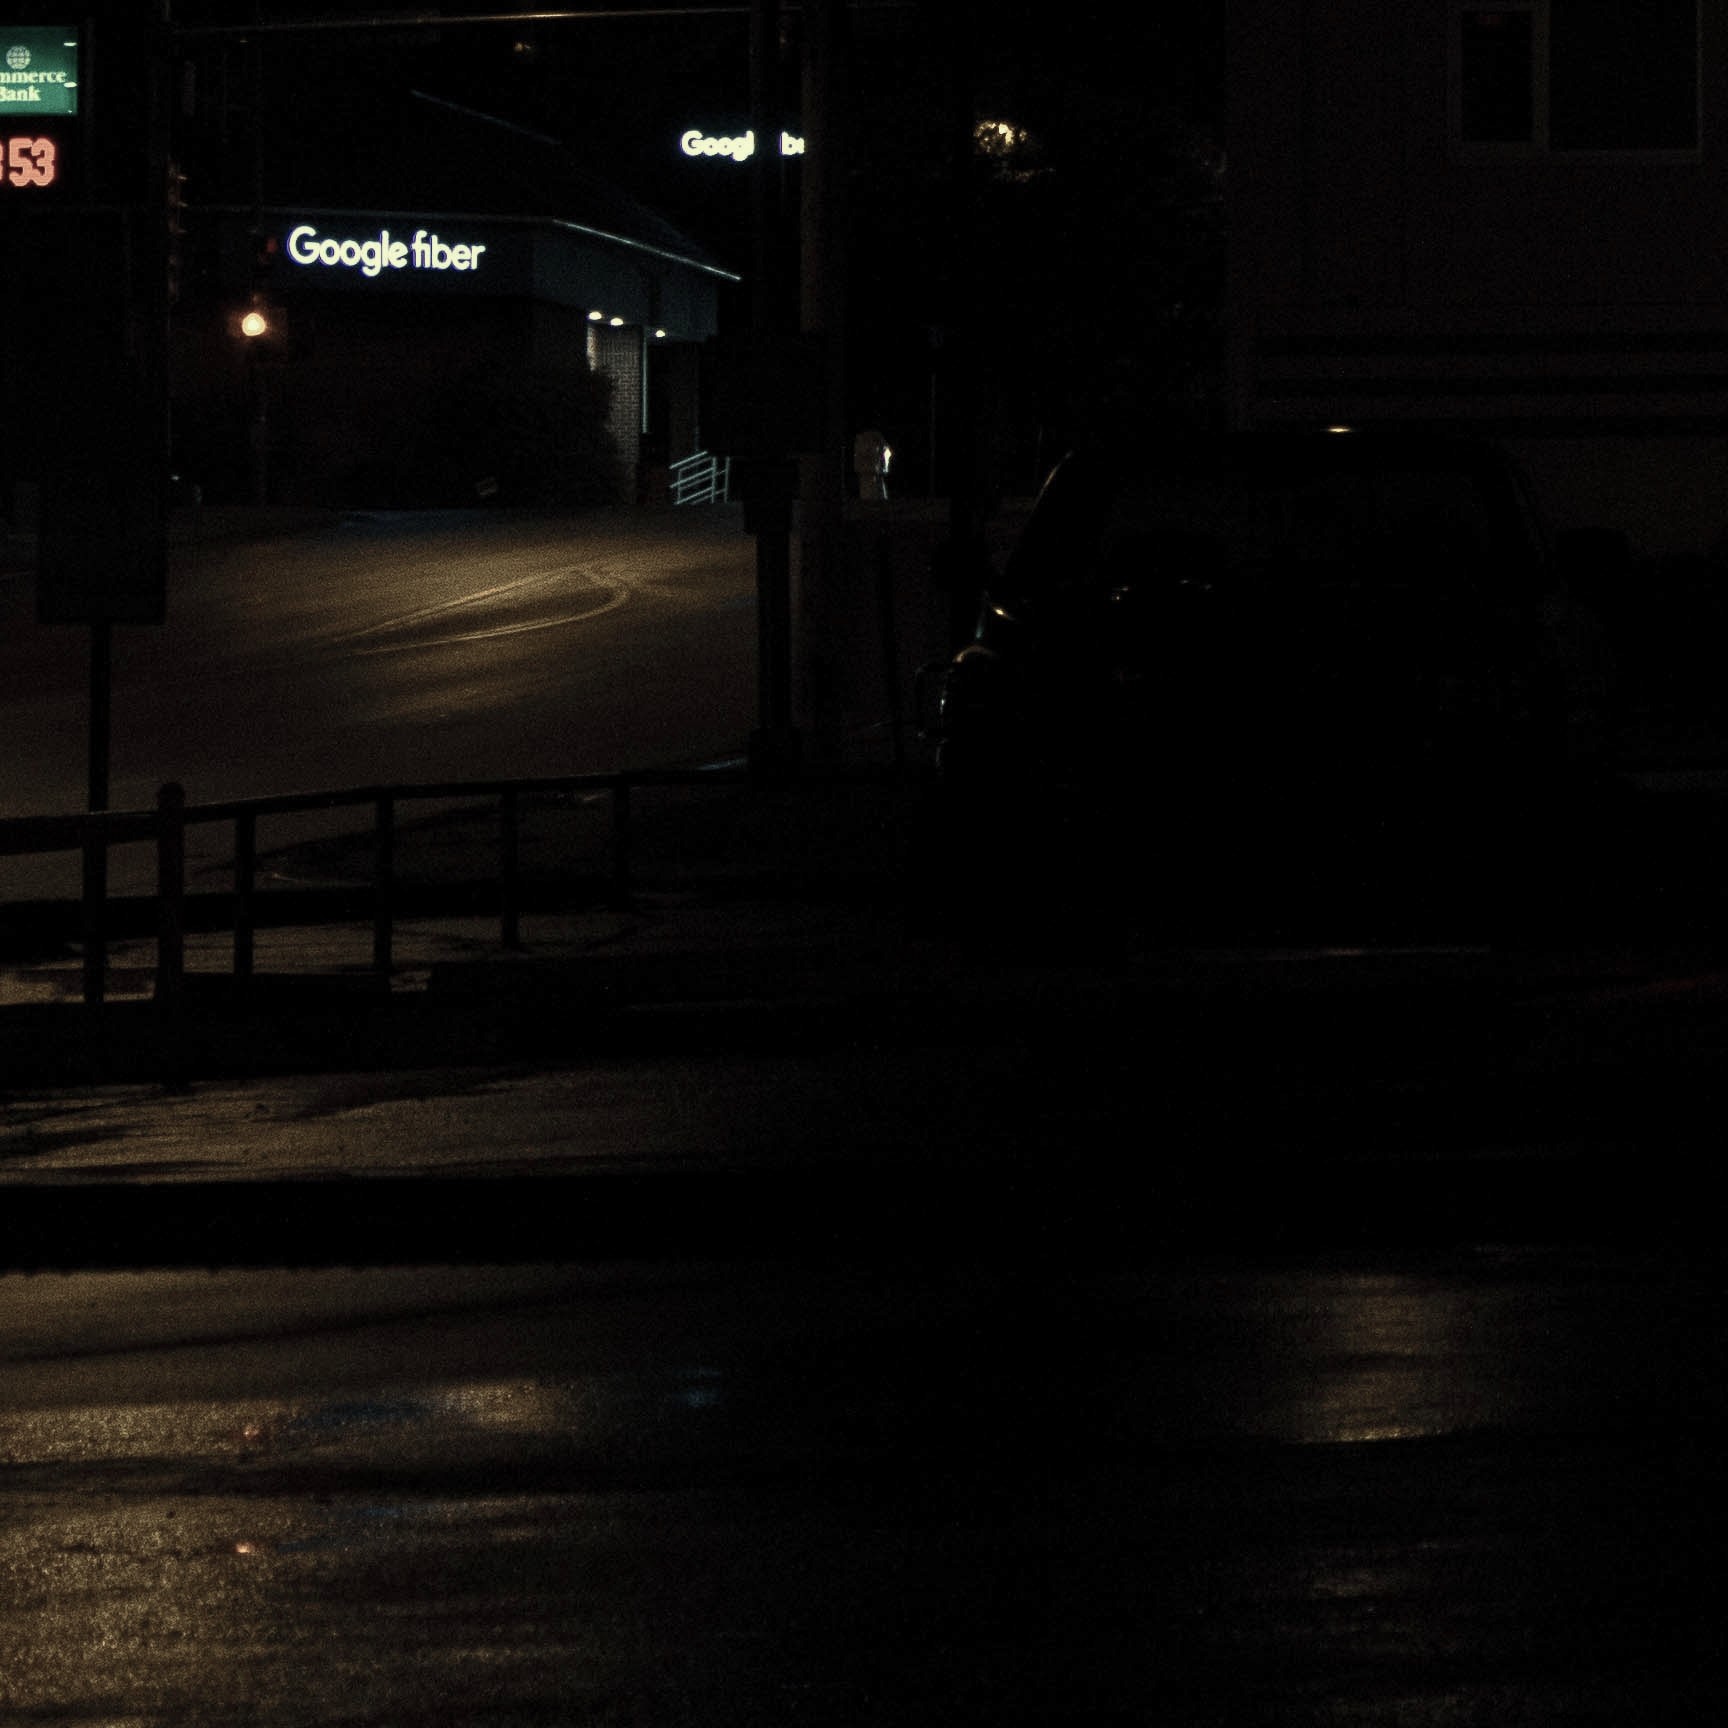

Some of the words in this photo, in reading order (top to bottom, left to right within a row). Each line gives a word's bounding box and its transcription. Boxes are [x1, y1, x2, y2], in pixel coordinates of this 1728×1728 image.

[0, 138, 55, 187] 53
[681, 130, 754, 161] Googl
[287, 225, 408, 277] Google
[411, 229, 486, 270] fiber
